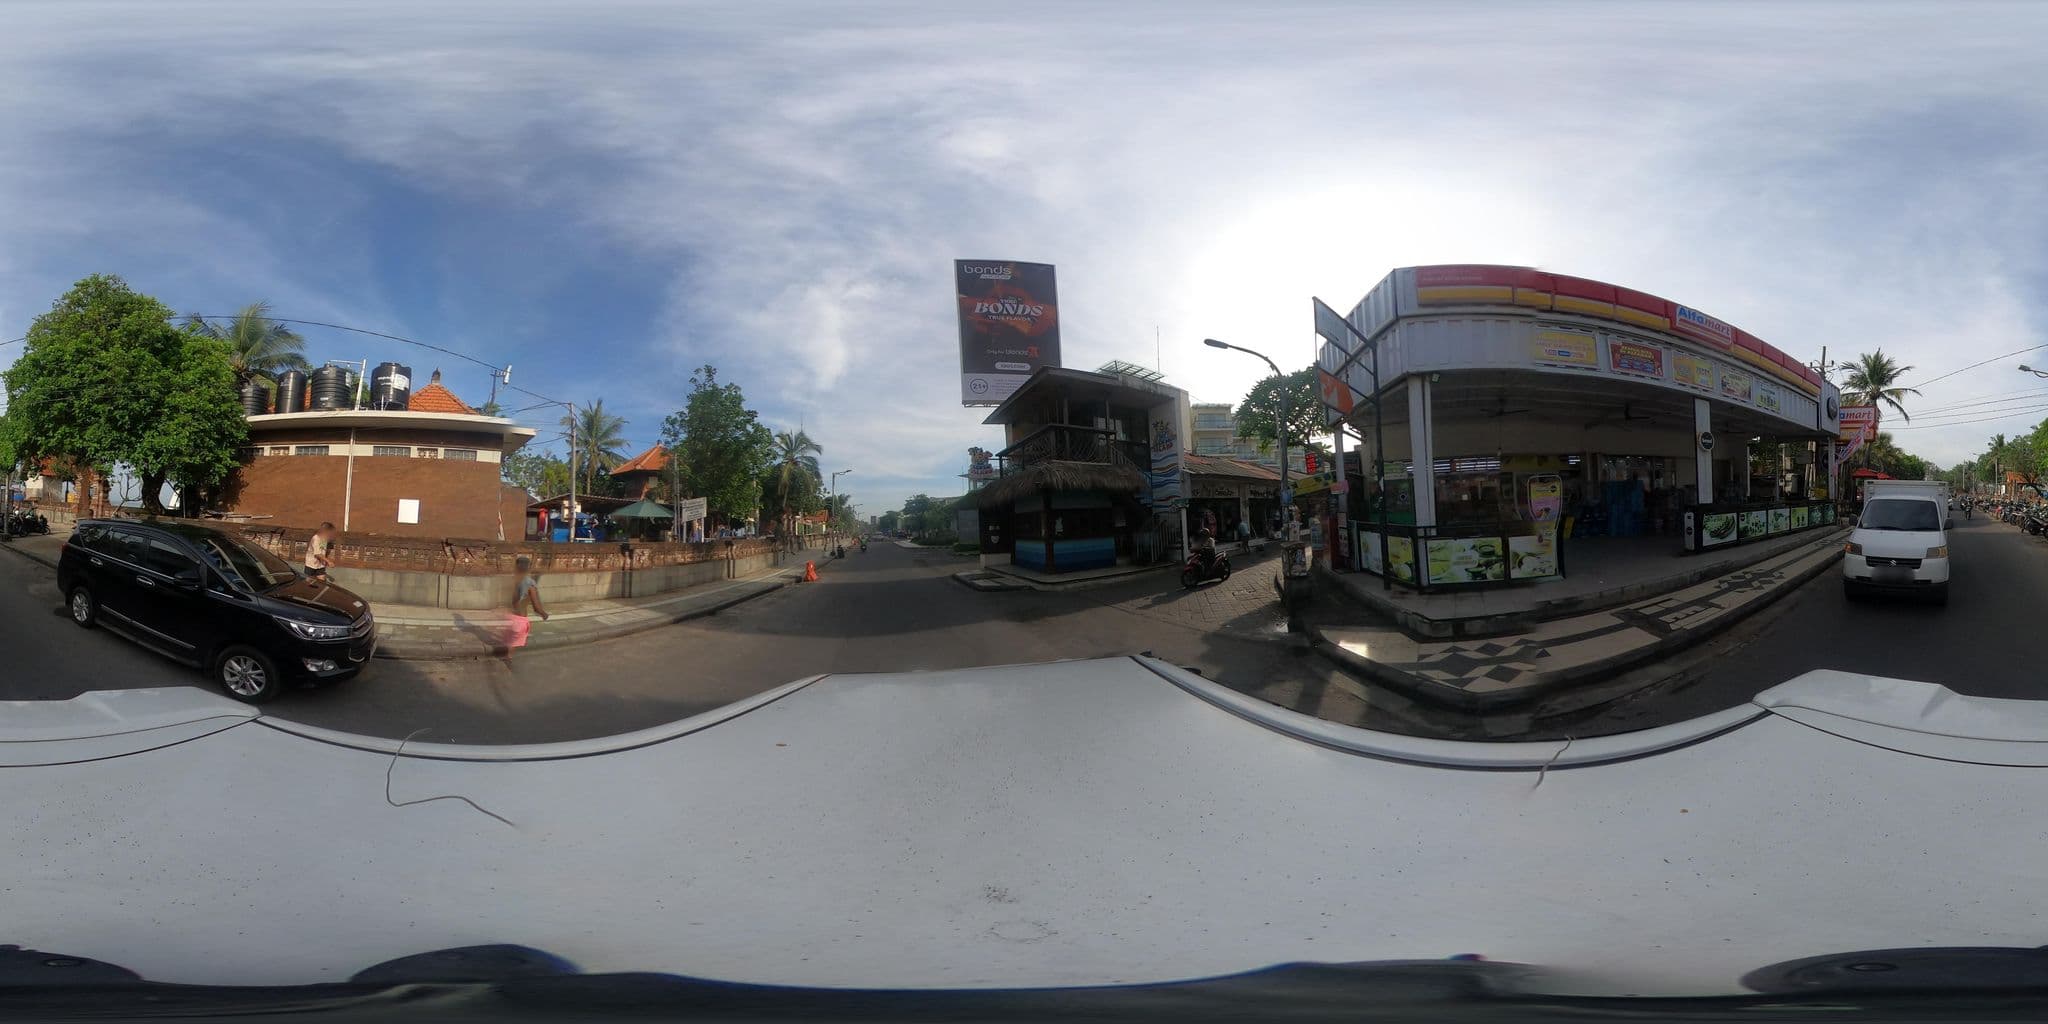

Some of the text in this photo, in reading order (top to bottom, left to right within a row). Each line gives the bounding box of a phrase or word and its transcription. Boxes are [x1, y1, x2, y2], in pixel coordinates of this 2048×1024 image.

[963, 264, 1012, 275] bonds
[974, 302, 1044, 317] BONDS
[1678, 307, 1730, 336] Alfamart
[1840, 410, 1873, 420] amart
